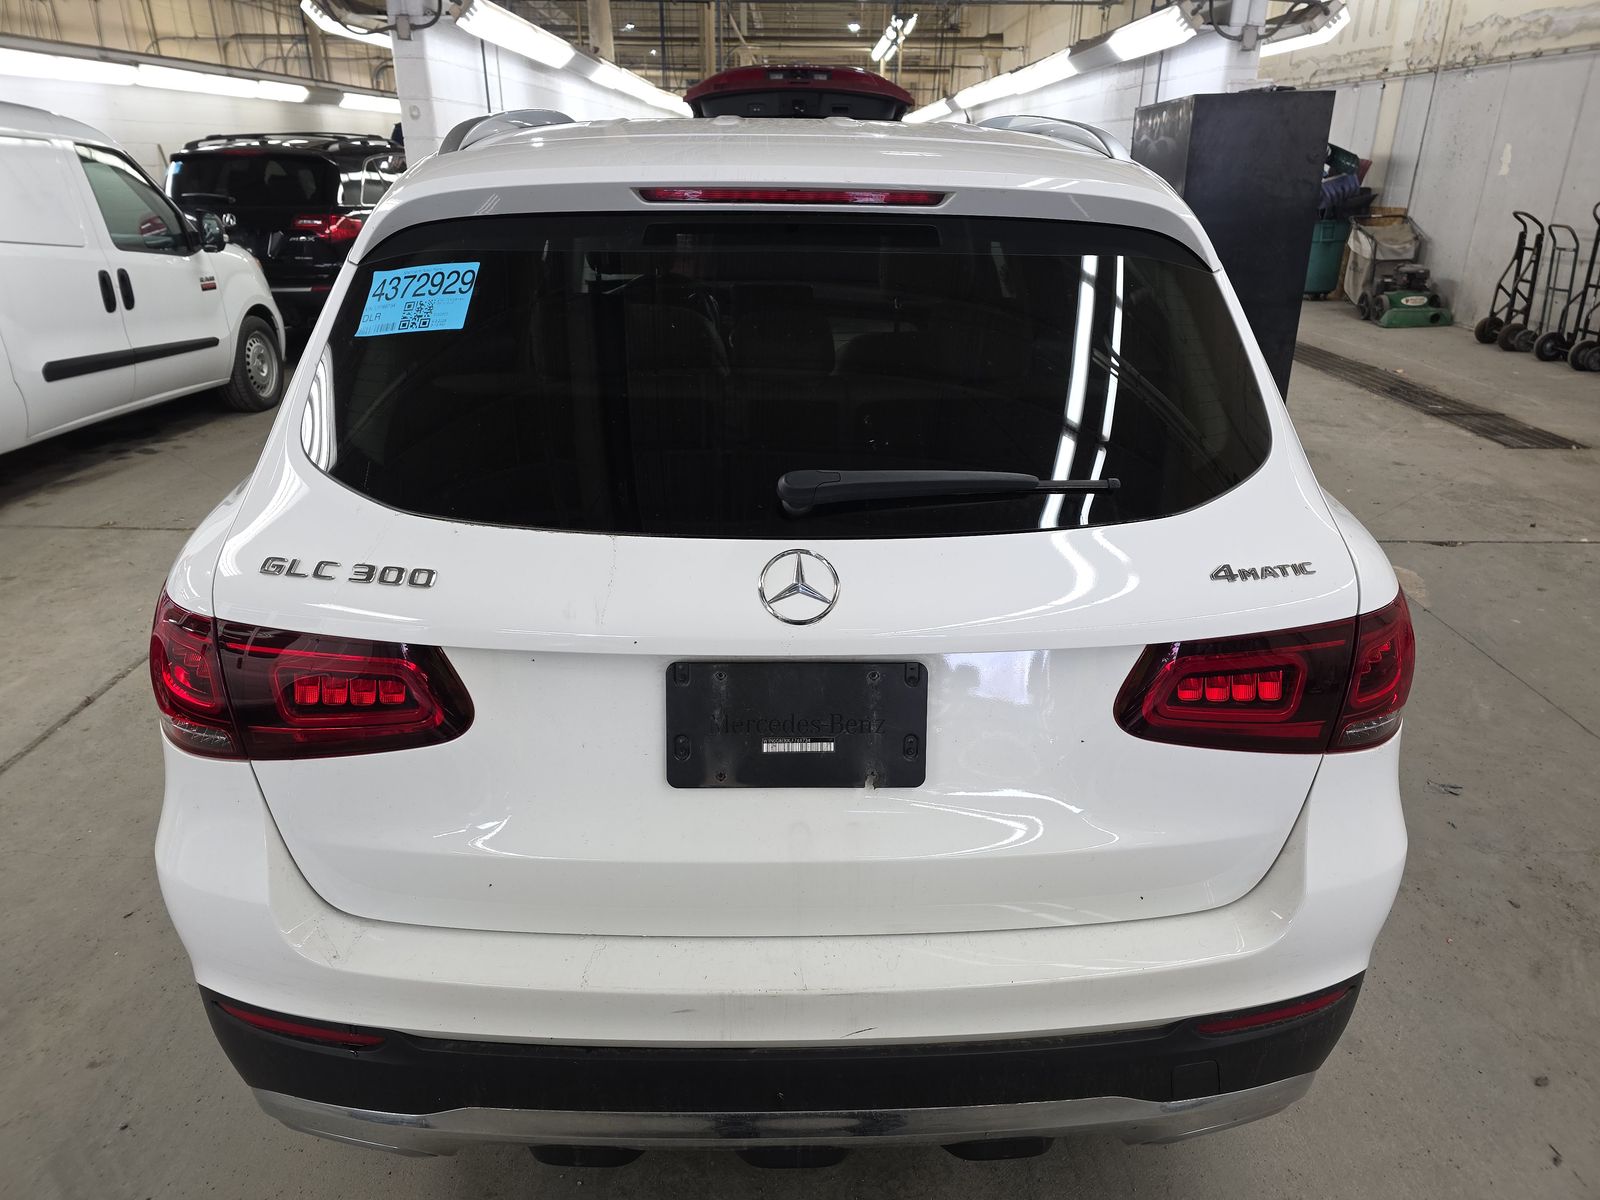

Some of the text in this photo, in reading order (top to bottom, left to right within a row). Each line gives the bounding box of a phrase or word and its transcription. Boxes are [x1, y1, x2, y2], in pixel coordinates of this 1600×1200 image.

[371, 269, 476, 302] 4372929
[361, 312, 382, 323] DLR
[259, 556, 438, 588] GLC 300
[1209, 561, 1317, 583] 4MATIC
[711, 713, 886, 735] Mercedes-Benz
